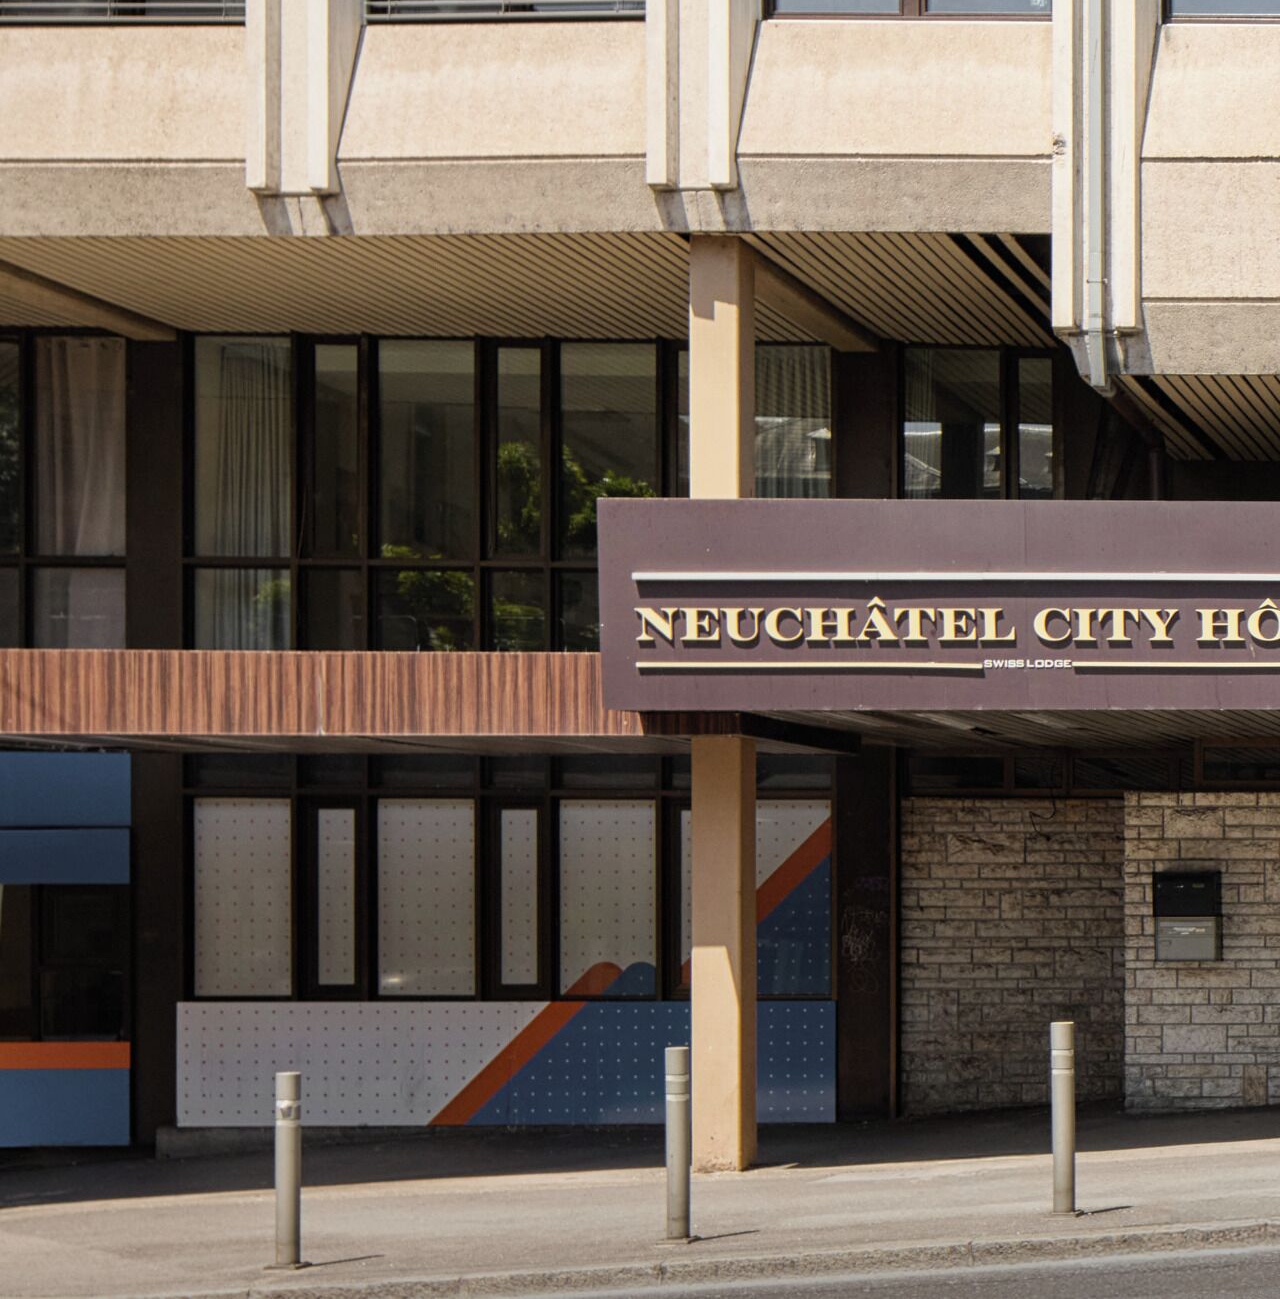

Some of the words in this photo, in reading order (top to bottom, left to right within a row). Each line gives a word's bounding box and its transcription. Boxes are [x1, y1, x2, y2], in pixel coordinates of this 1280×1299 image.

[634, 596, 1016, 642] NEUCHÂTEL
[1033, 607, 1179, 642] CITY
[983, 659, 1025, 668] SWISS
[1026, 659, 1072, 668] LODGE
